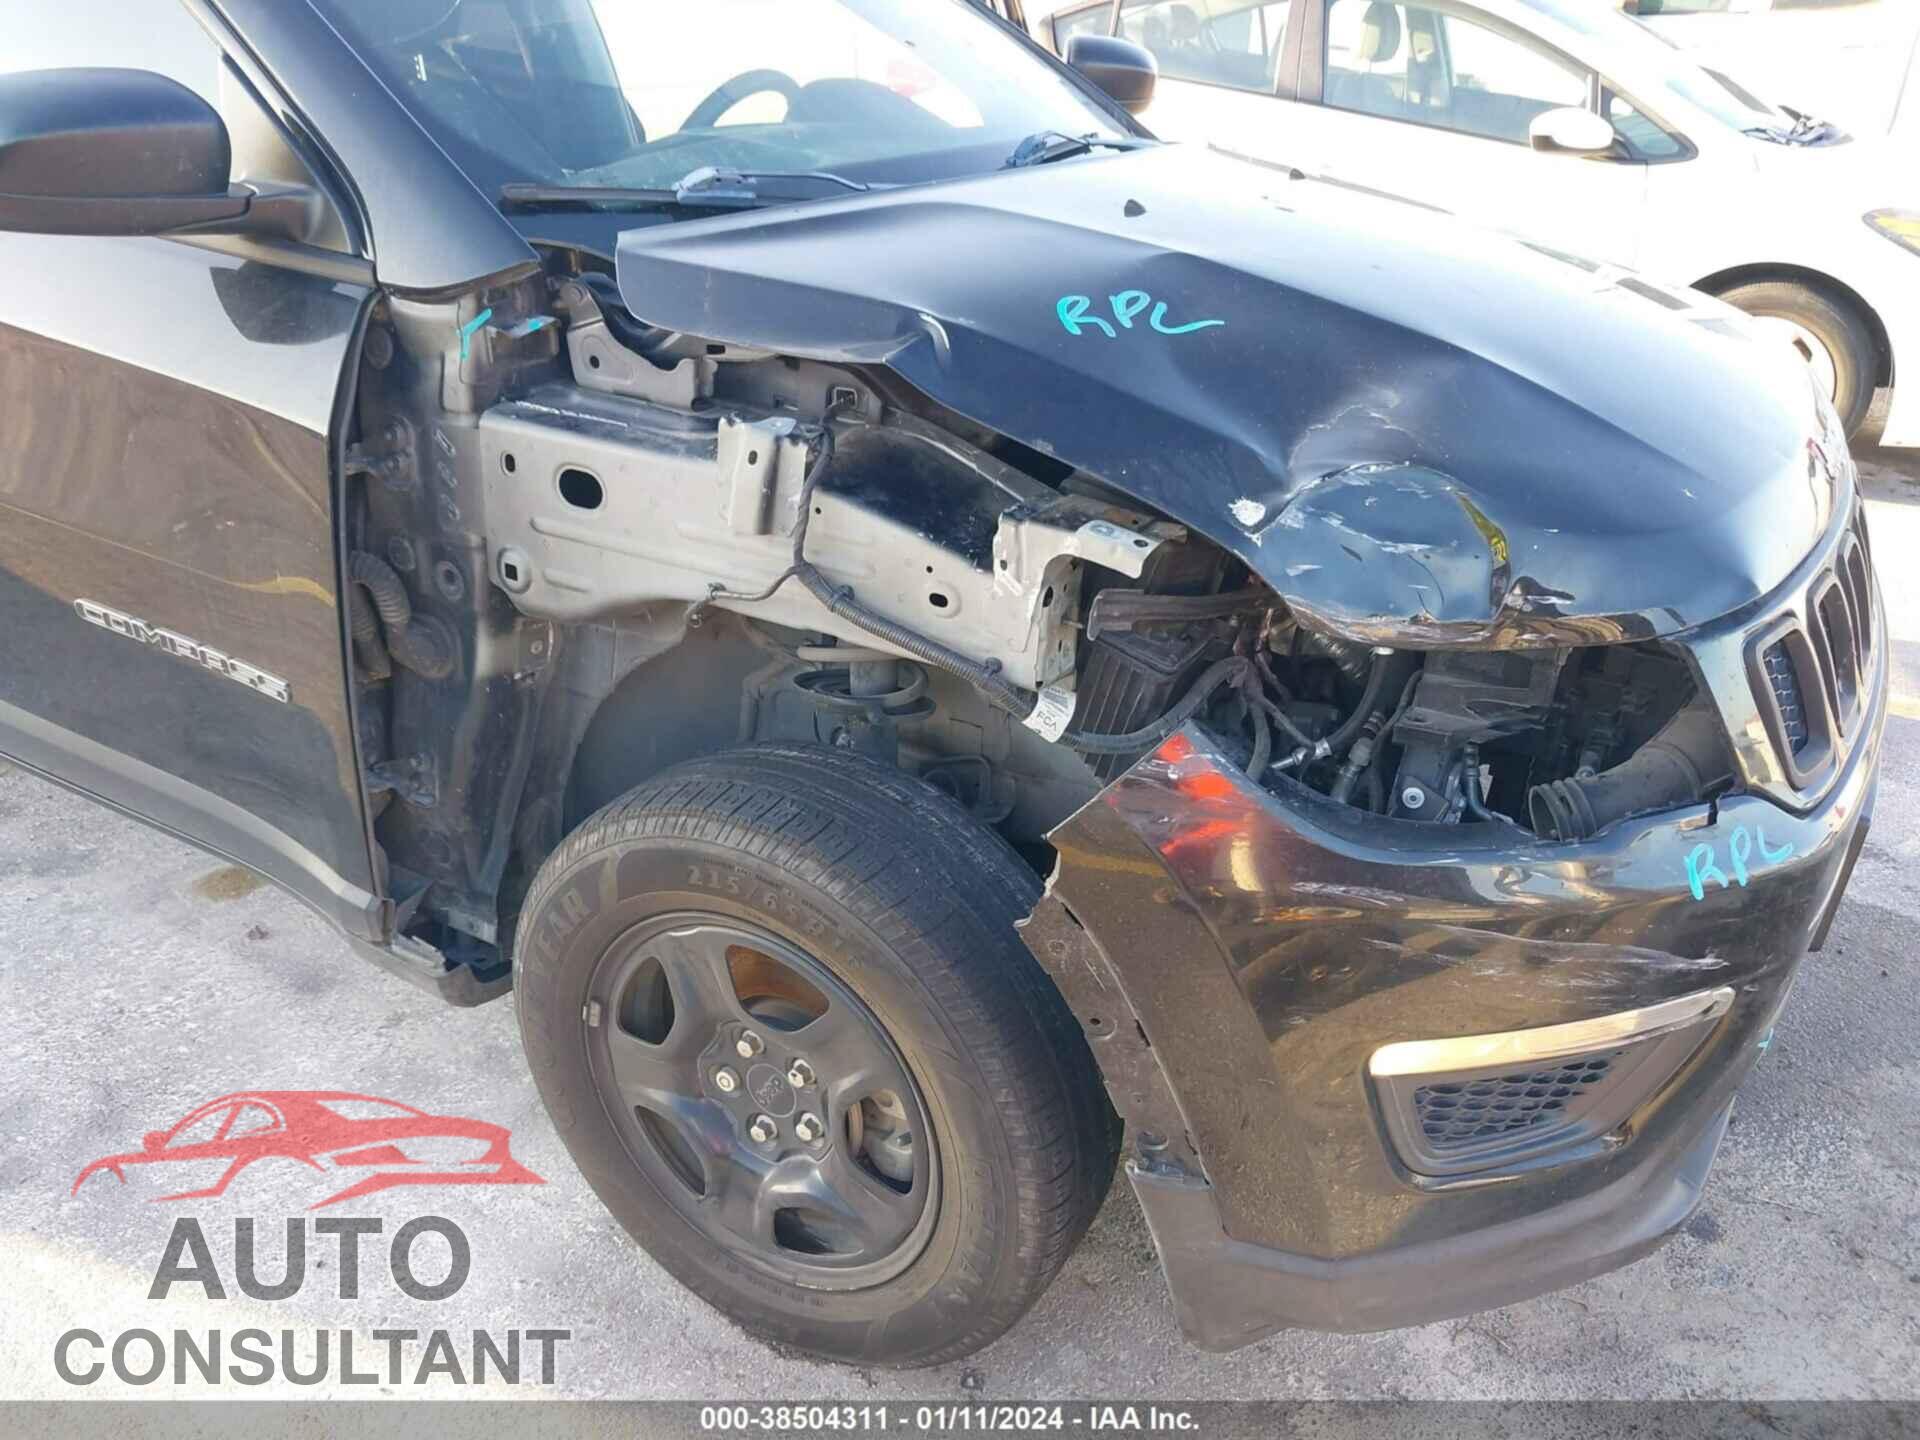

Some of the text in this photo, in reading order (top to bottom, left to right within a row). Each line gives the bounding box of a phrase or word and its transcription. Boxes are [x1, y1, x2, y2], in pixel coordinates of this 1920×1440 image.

[1056, 290, 1225, 338] RPL
[74, 598, 292, 704] COMPASS
[1683, 825, 1793, 900] RPL
